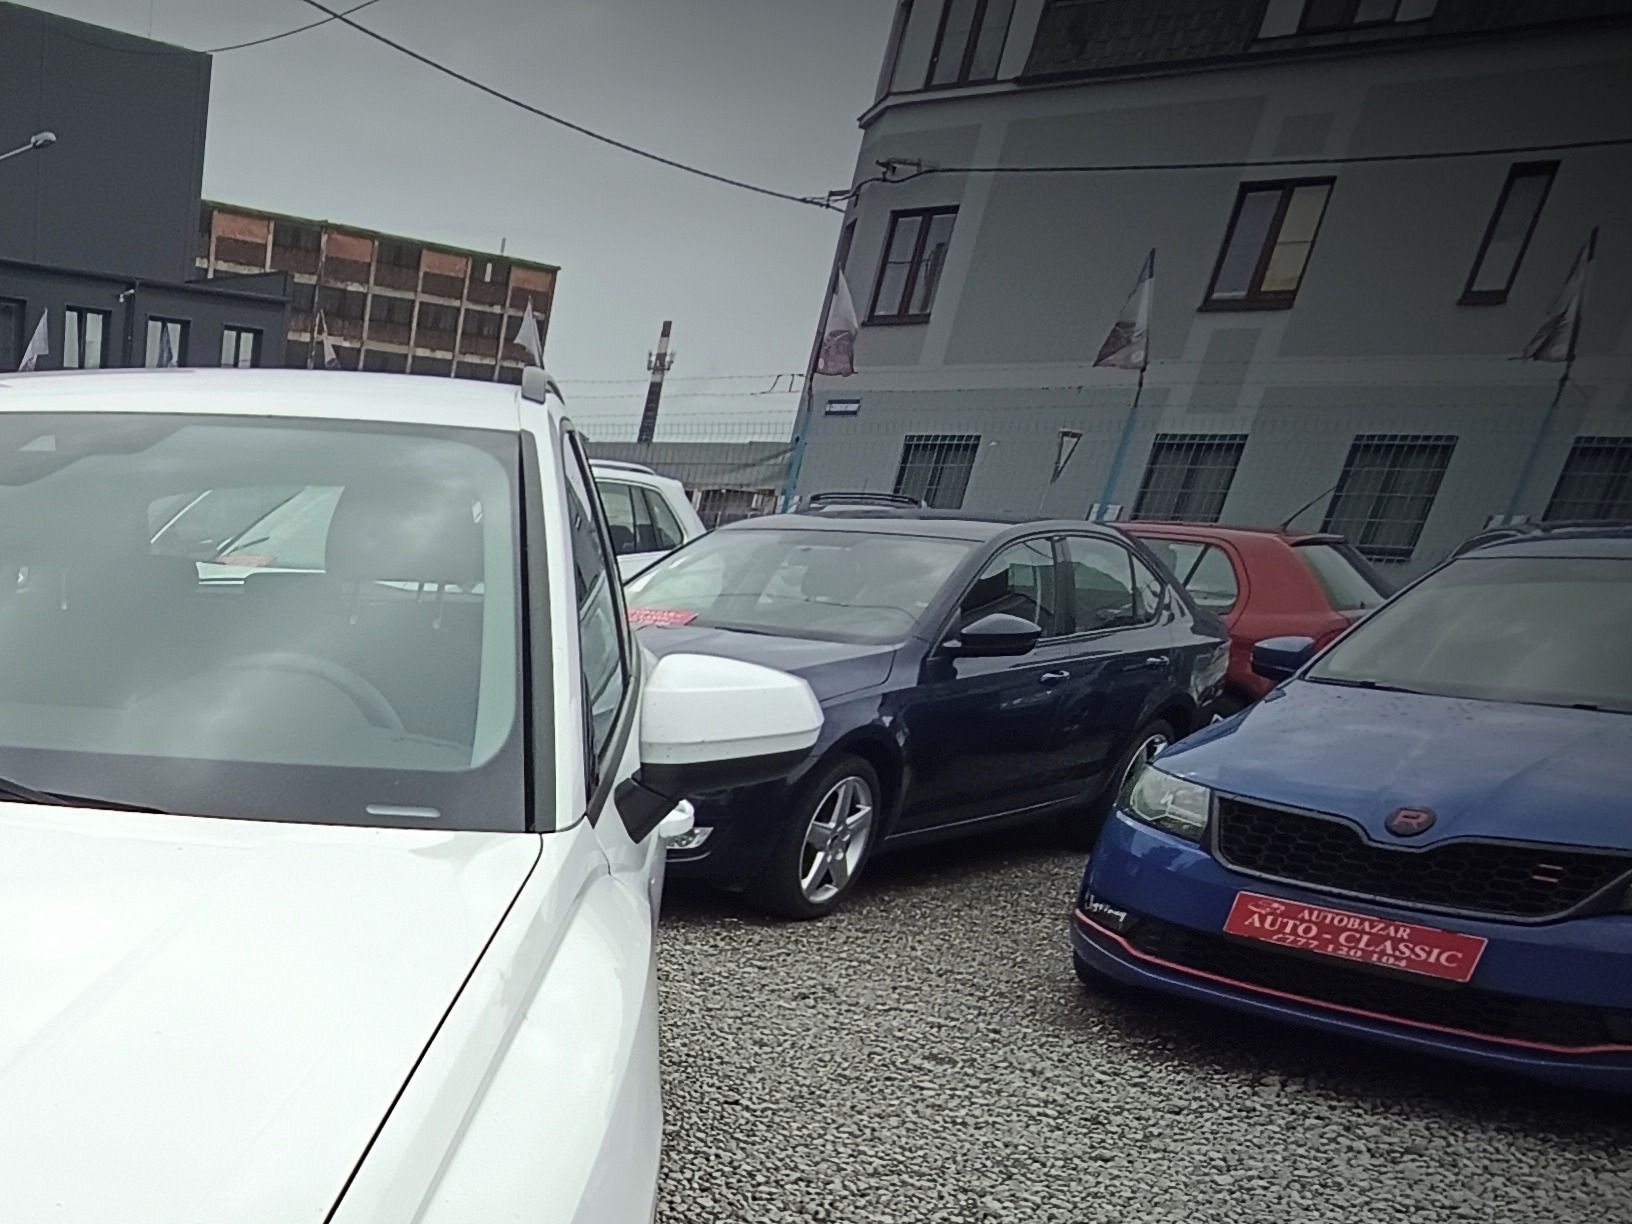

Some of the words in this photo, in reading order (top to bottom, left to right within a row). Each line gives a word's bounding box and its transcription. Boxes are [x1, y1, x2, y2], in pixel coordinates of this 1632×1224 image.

[1244, 912, 1318, 938] AUTO
[1338, 931, 1463, 968] CLASSIC
[1298, 909, 1411, 940] AUTOBAZAR
